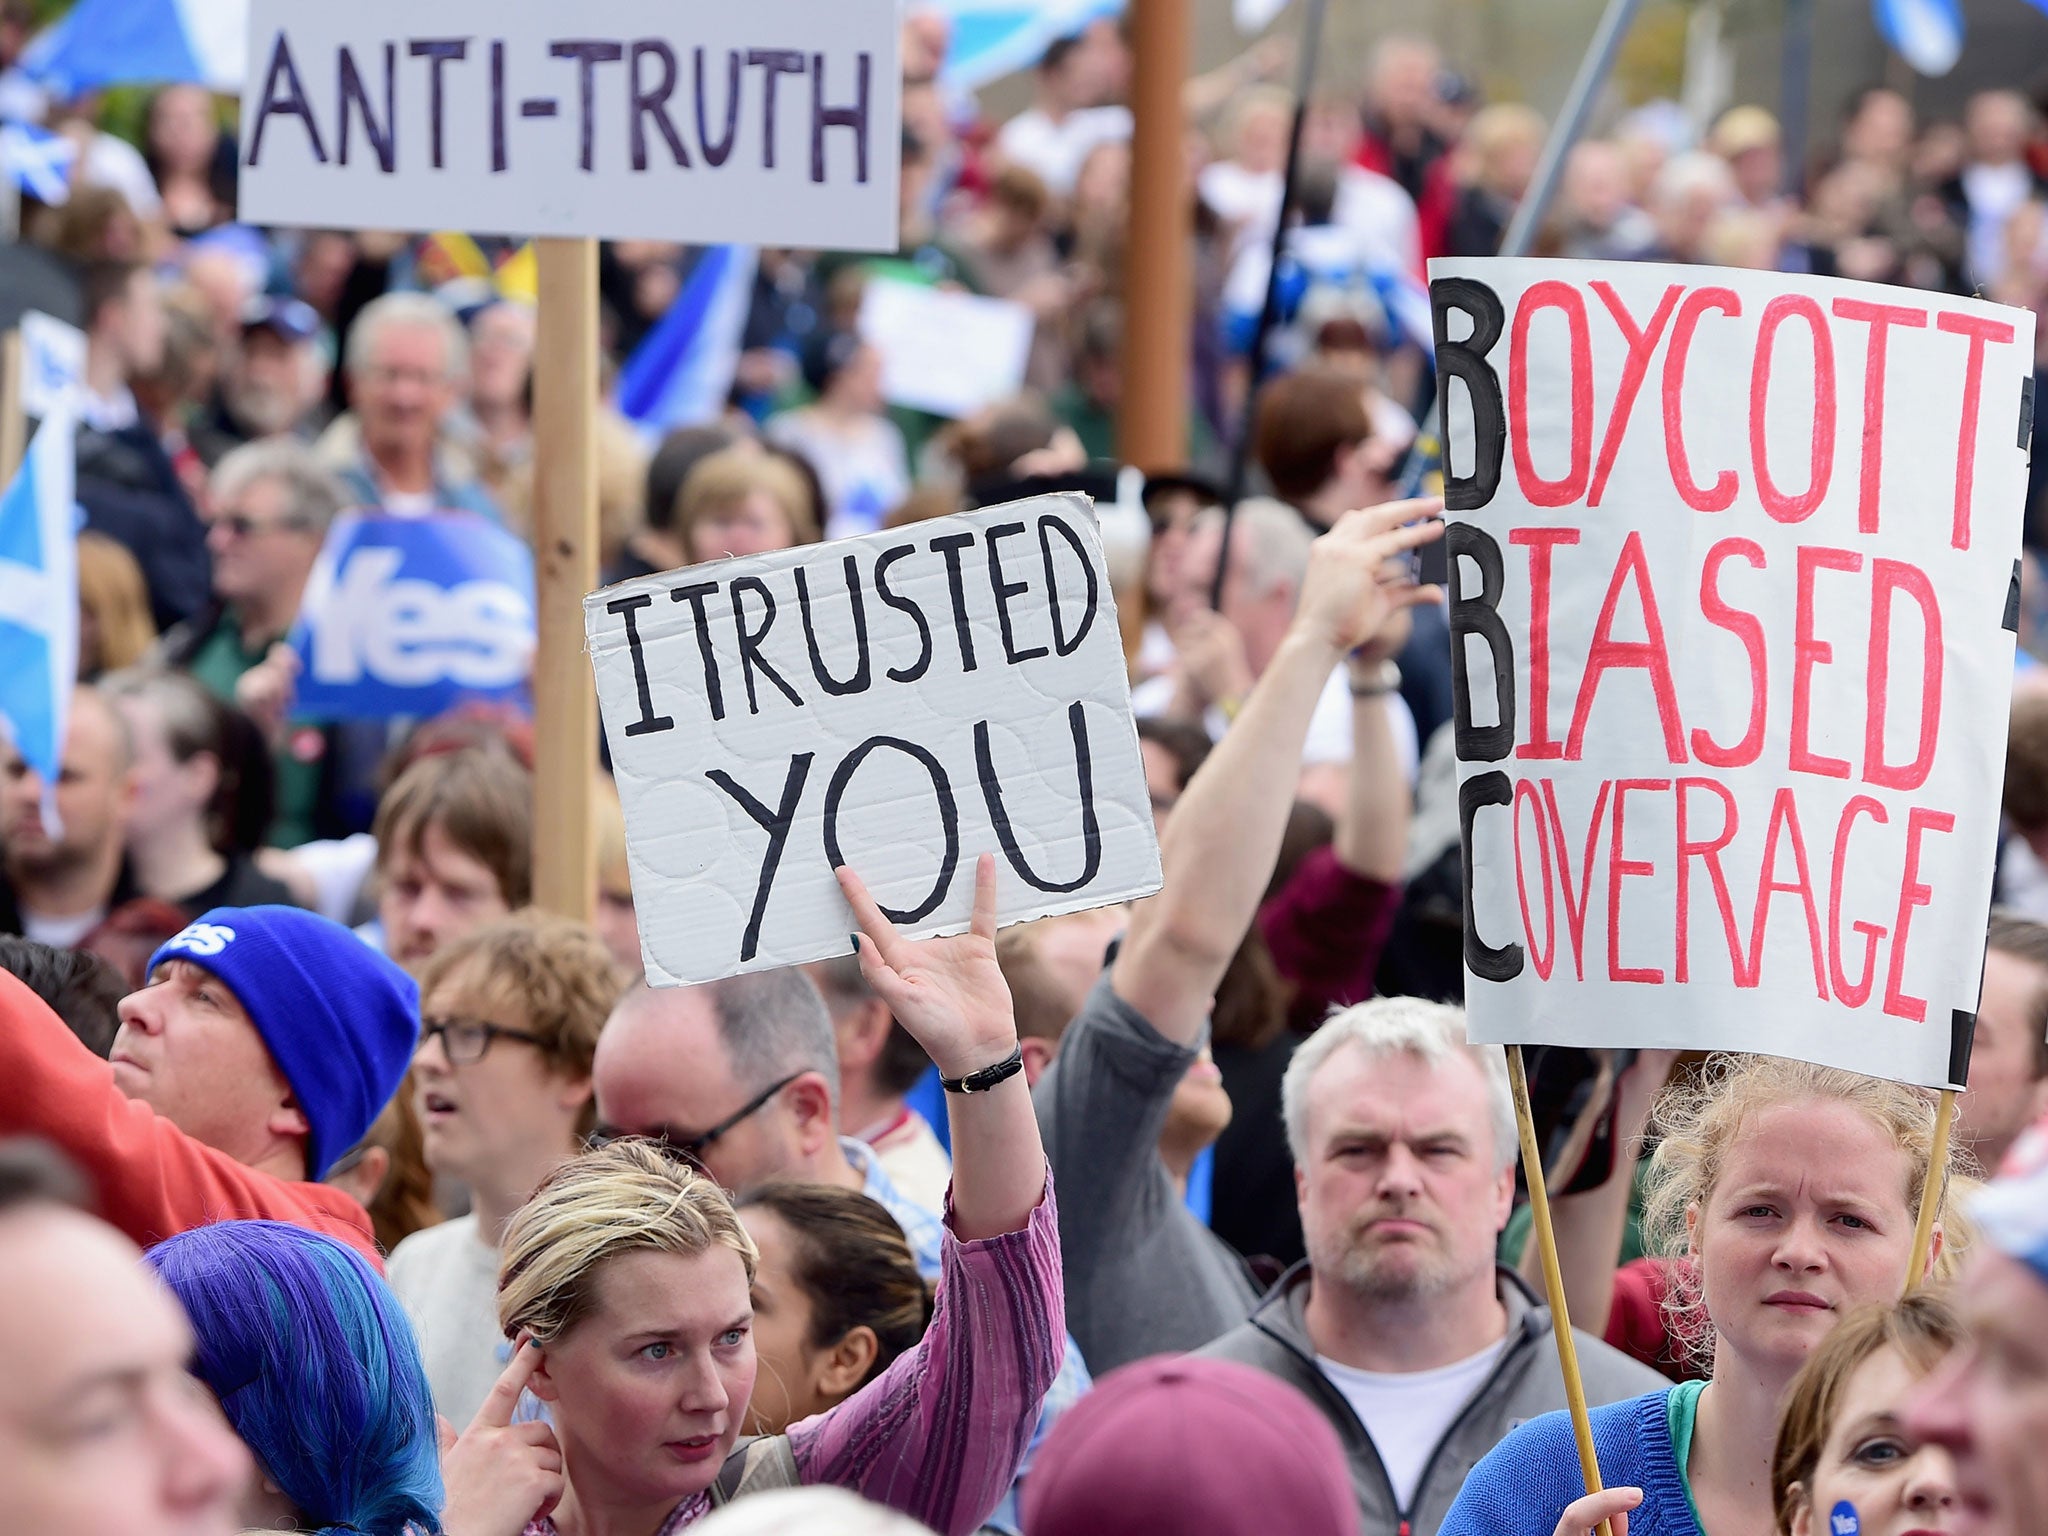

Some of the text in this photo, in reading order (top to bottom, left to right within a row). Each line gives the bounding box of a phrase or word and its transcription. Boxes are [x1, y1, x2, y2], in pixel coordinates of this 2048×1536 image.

[242, 32, 871, 184] ANTI-TRUTH
[1431, 277, 2016, 552] BOYCOTT
[303, 546, 537, 690] Yes
[606, 513, 1098, 737] I TRUSTED
[1446, 522, 1945, 792] BIASED
[704, 700, 1102, 963] YOU
[1459, 770, 1956, 1024] COVERAGE
